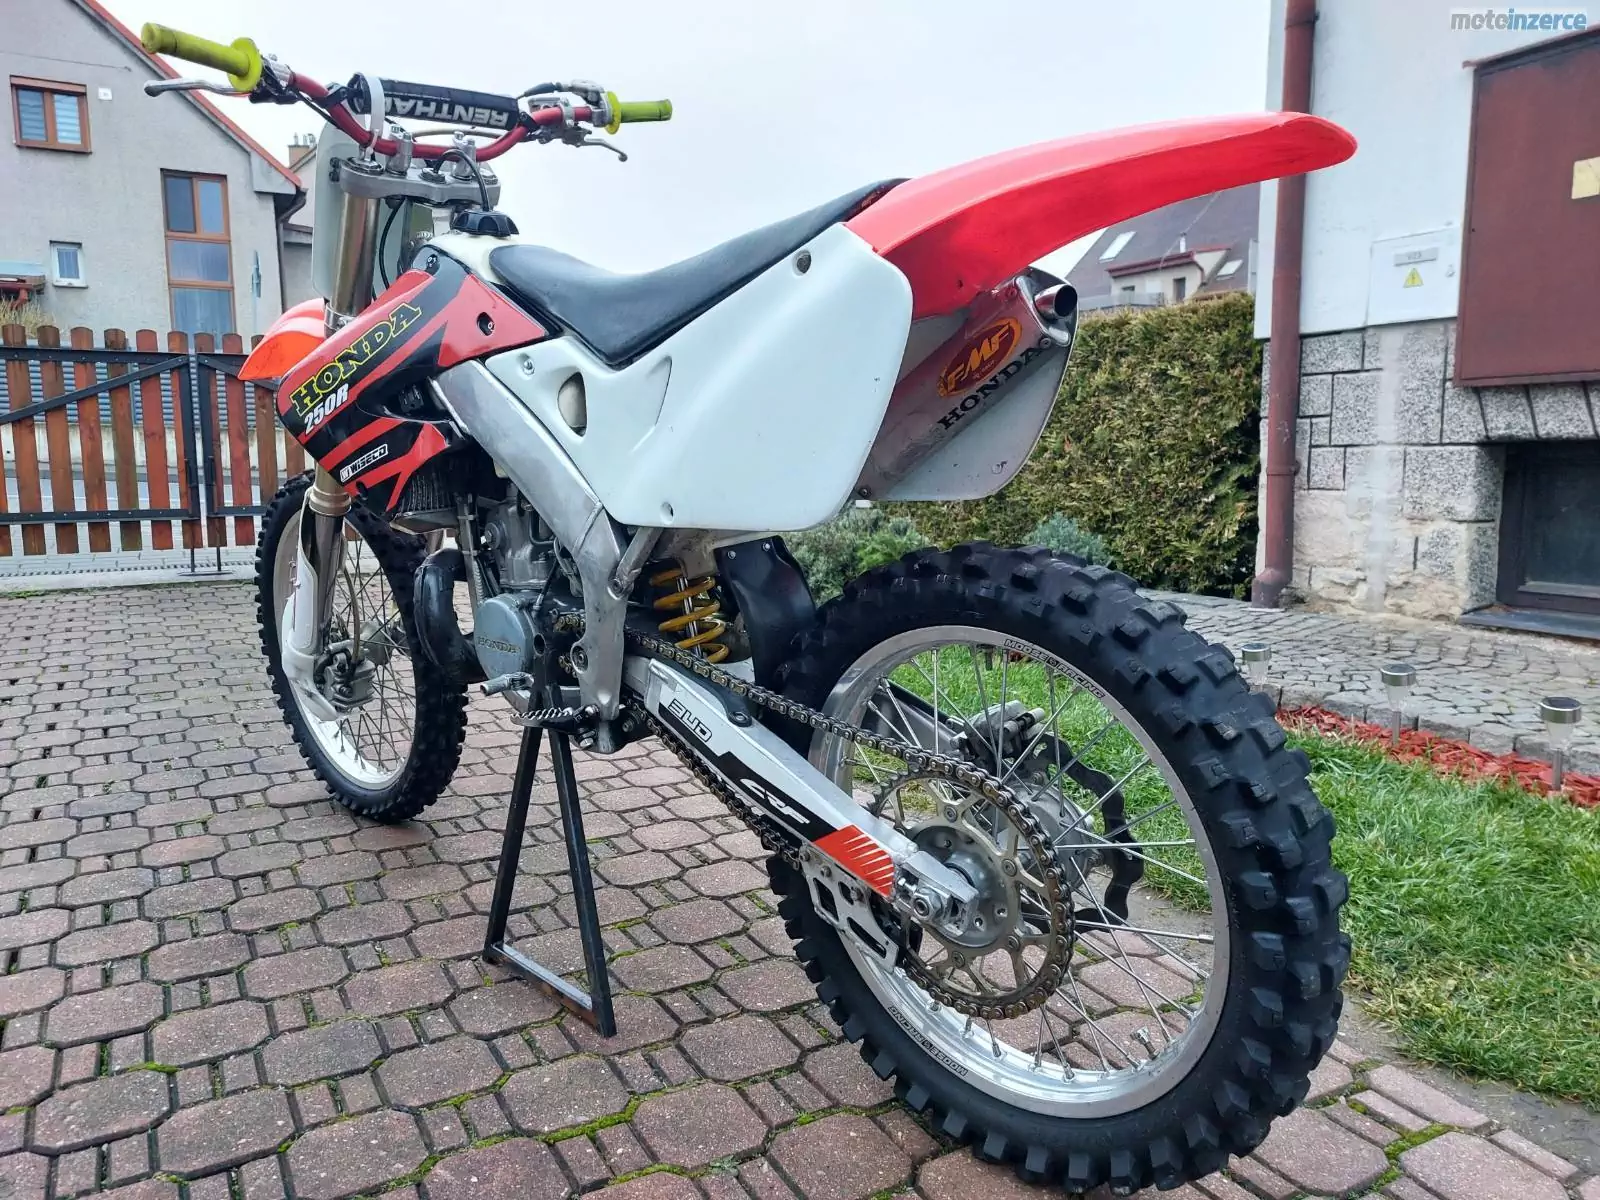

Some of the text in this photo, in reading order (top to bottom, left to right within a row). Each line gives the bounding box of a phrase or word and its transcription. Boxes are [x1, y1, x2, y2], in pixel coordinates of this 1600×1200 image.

[289, 302, 422, 417] HONDA
[936, 346, 1045, 430] HONDA
[947, 323, 1010, 393] FMF
[304, 382, 349, 435] 250R
[1004, 639, 1106, 698] MOOSE RACING
[887, 1005, 969, 1077] MOOSE RACING
